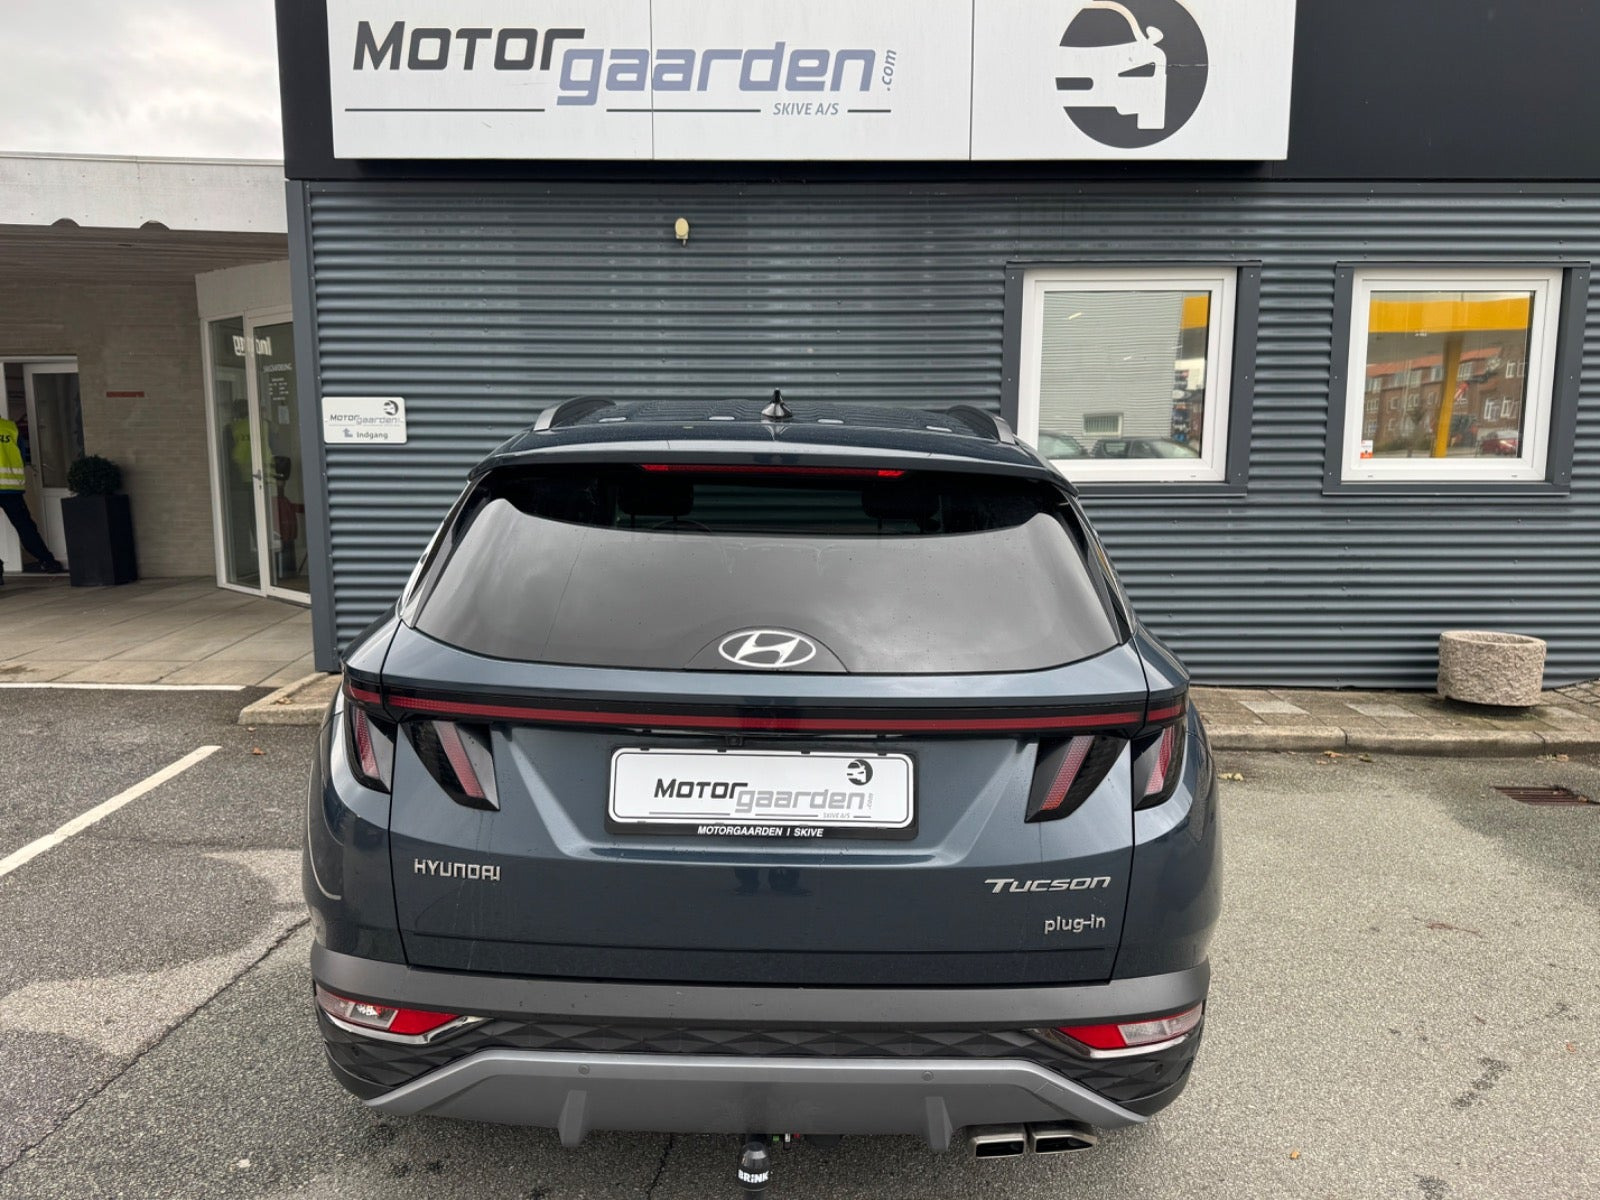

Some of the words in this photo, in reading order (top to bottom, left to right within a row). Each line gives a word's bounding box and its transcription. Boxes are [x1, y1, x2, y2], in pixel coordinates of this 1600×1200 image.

[773, 102, 812, 116] SKIVE
[815, 102, 840, 116] A/S
[0, 434, 11, 443] LS
[356, 431, 389, 440] Indgang
[697, 825, 782, 837] MOTORGAARDEN
[793, 827, 824, 838] SKIVE
[413, 858, 501, 881] HYUNDAI
[1044, 914, 1106, 934] plug-in
